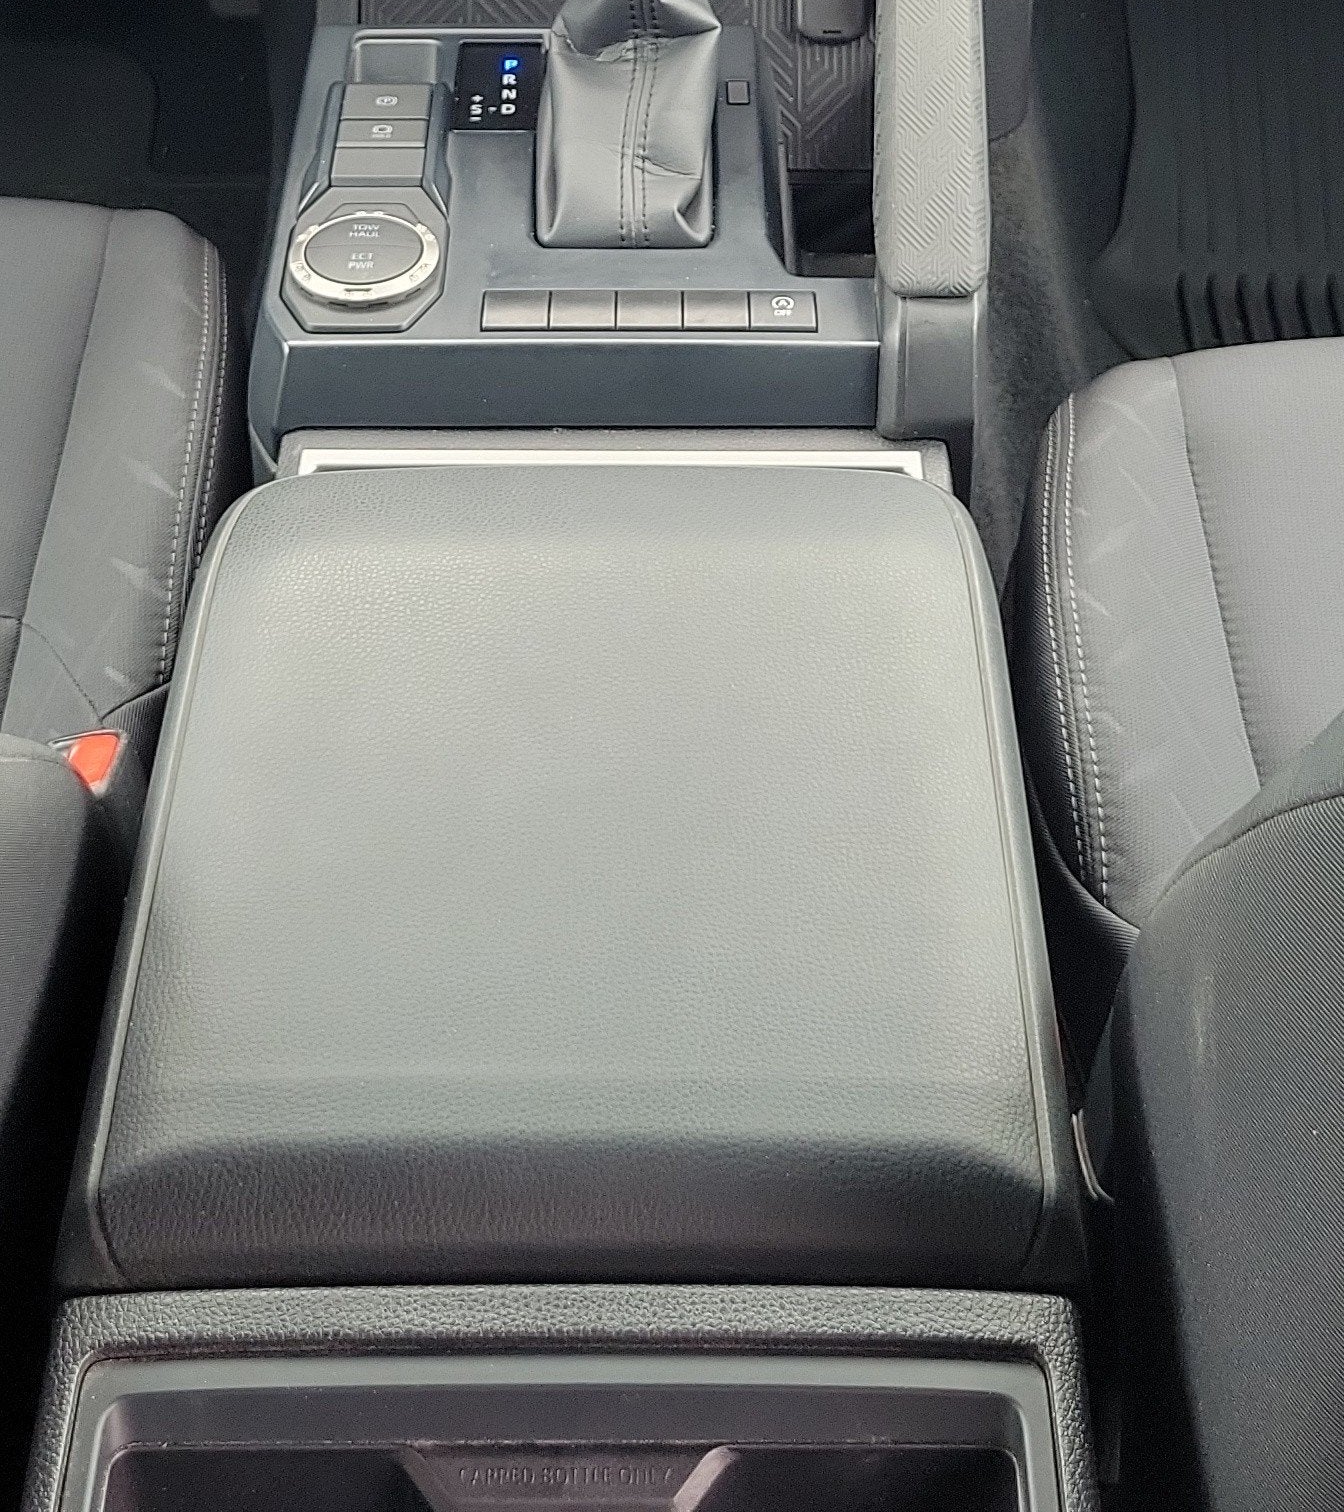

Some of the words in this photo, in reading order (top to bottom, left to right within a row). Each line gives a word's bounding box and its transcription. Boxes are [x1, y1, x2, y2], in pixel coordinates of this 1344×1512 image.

[504, 59, 518, 71] P
[502, 74, 517, 85] R
[501, 89, 517, 100] N
[501, 104, 516, 115] D
[353, 223, 381, 231] TOW
[352, 252, 374, 260] ECT
[348, 261, 374, 269] PWR
[459, 1467, 536, 1486] CAPPED
[542, 1467, 611, 1486] BOTTLE
